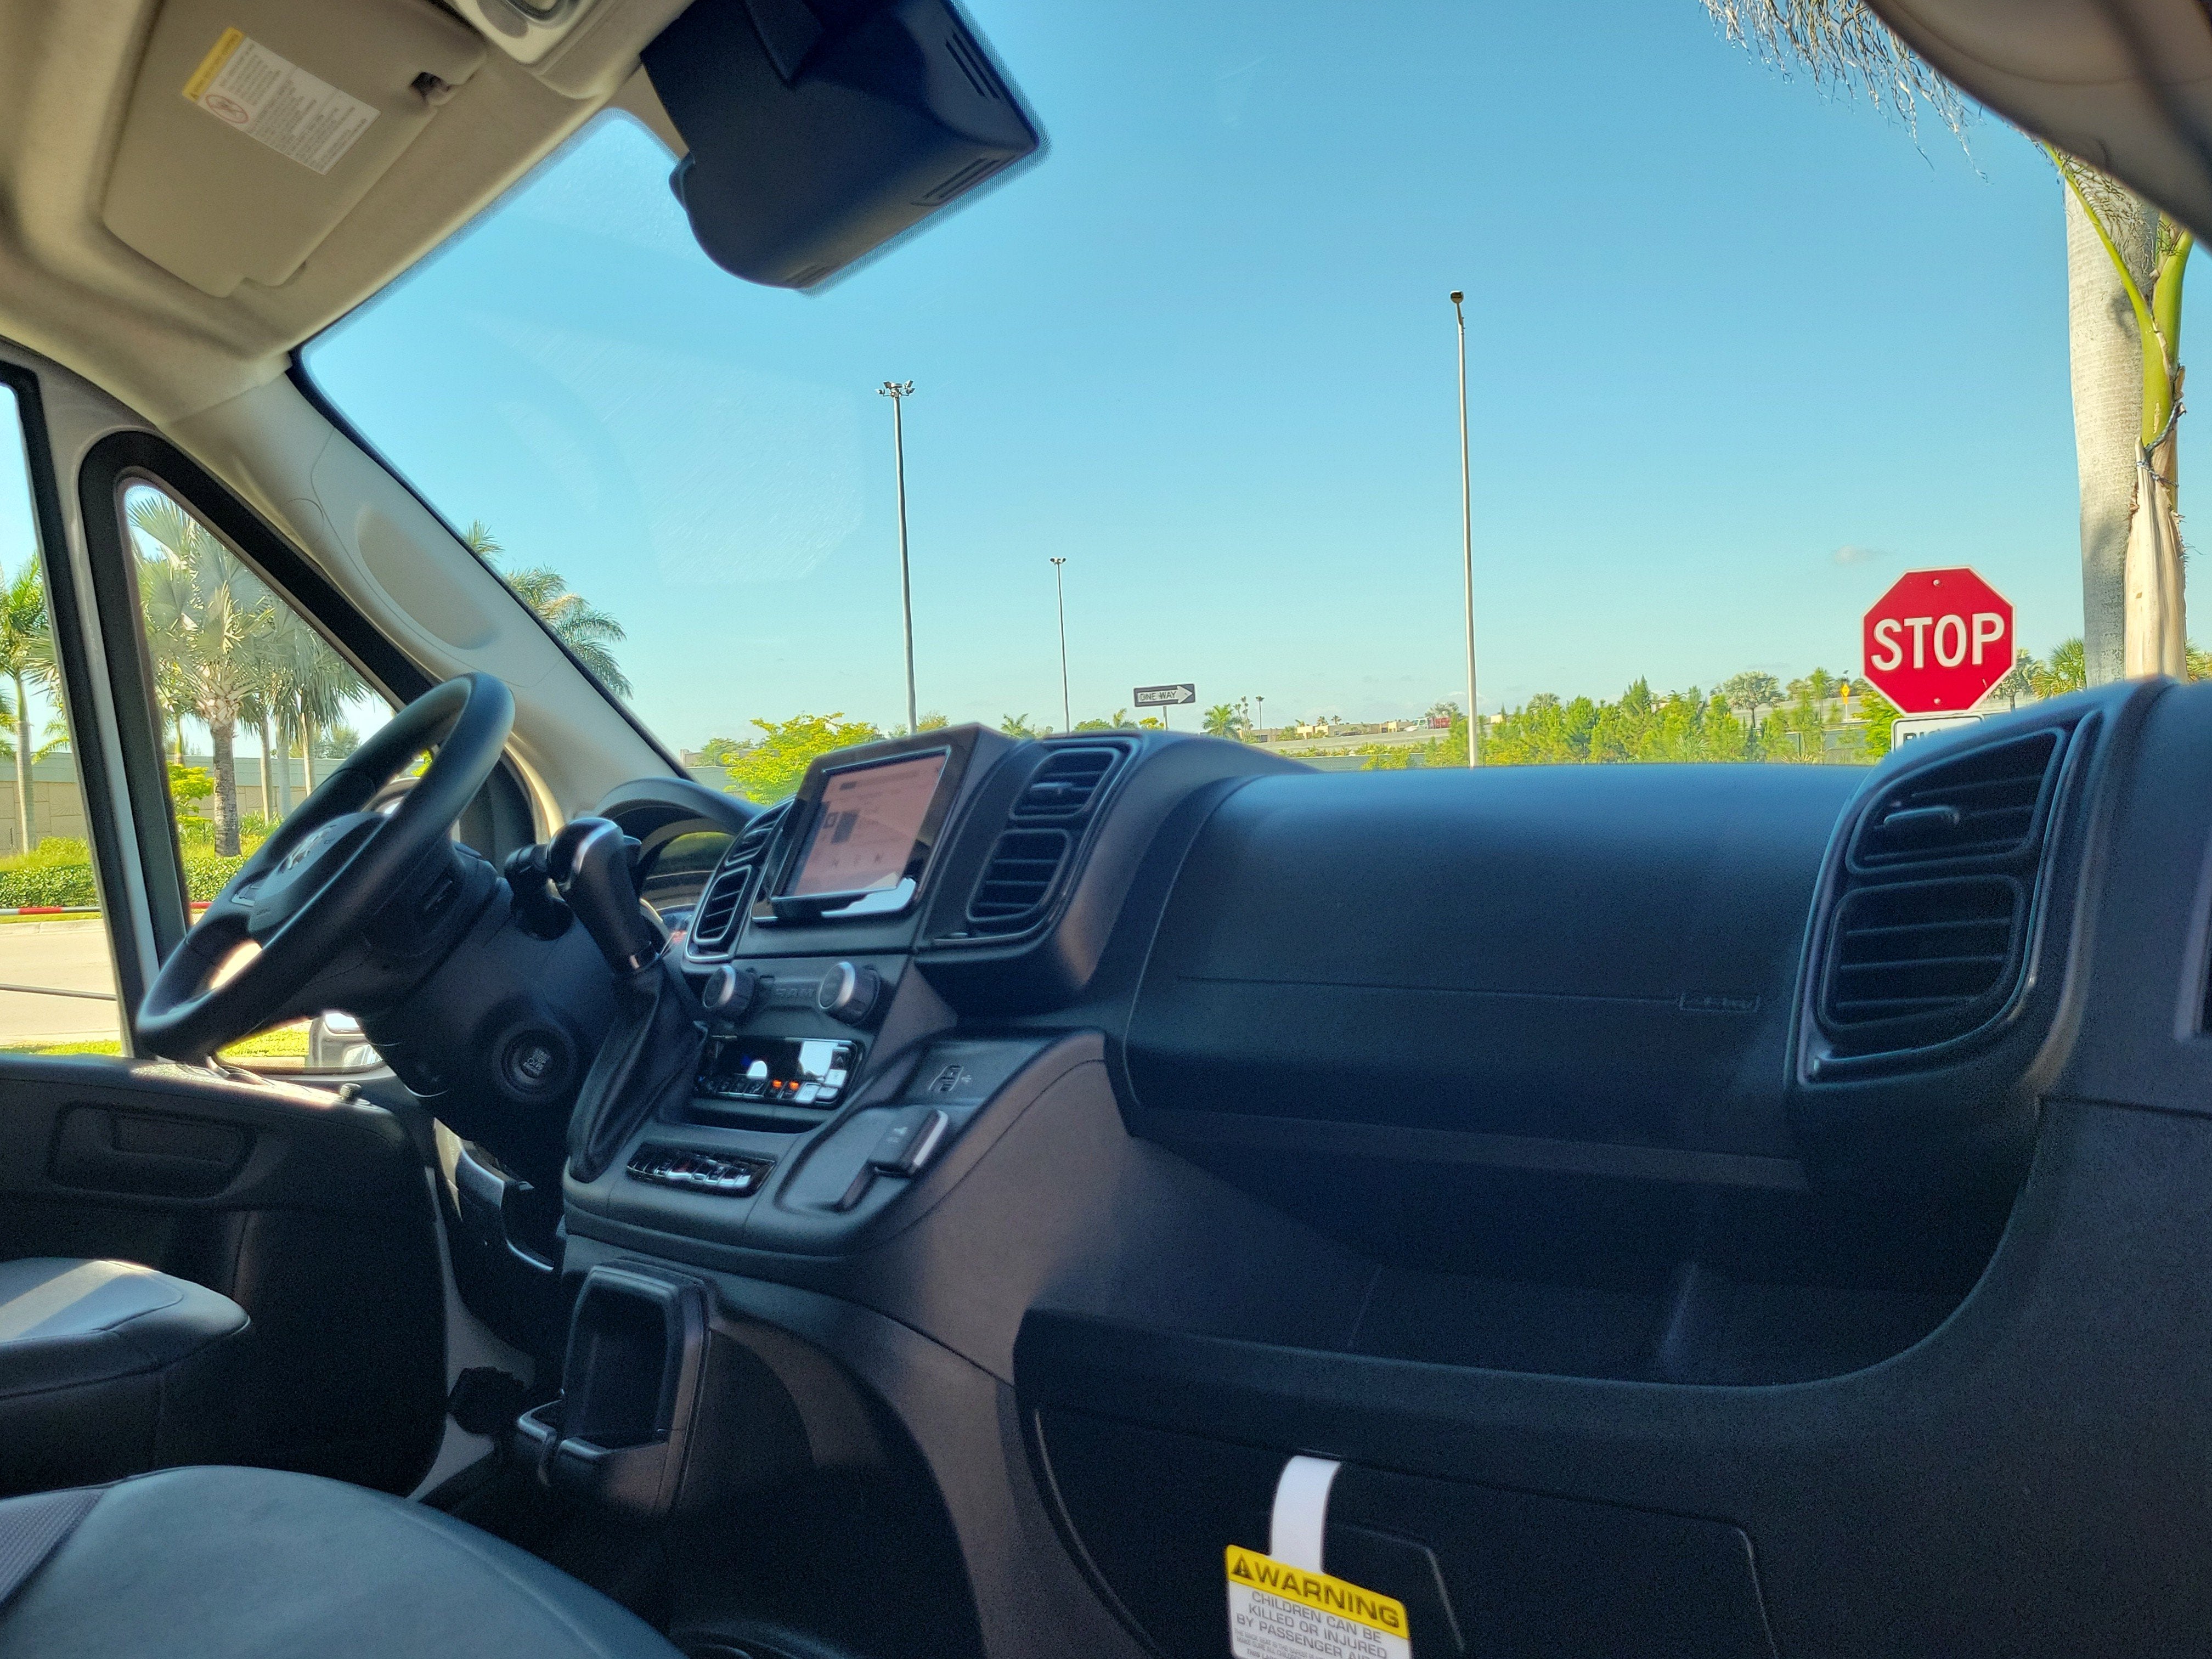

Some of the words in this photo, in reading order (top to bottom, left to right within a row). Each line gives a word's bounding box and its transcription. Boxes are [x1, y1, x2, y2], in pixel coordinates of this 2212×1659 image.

[1871, 612, 2005, 672] STOP
[1139, 692, 1157, 701] ONE
[1159, 691, 1177, 699] WAY
[1252, 1590, 1322, 1623] CHILDREN
[1327, 1615, 1357, 1635] CAN
[1363, 1627, 1382, 1644] BE
[1254, 1560, 1399, 1628] WARNING
[1236, 1613, 1254, 1627] BY
[1259, 1620, 1342, 1658] PASSENGER
[1249, 1602, 1295, 1628] KILLED
[1299, 1621, 1319, 1637] OR
[1324, 1628, 1387, 1659] INJURED
